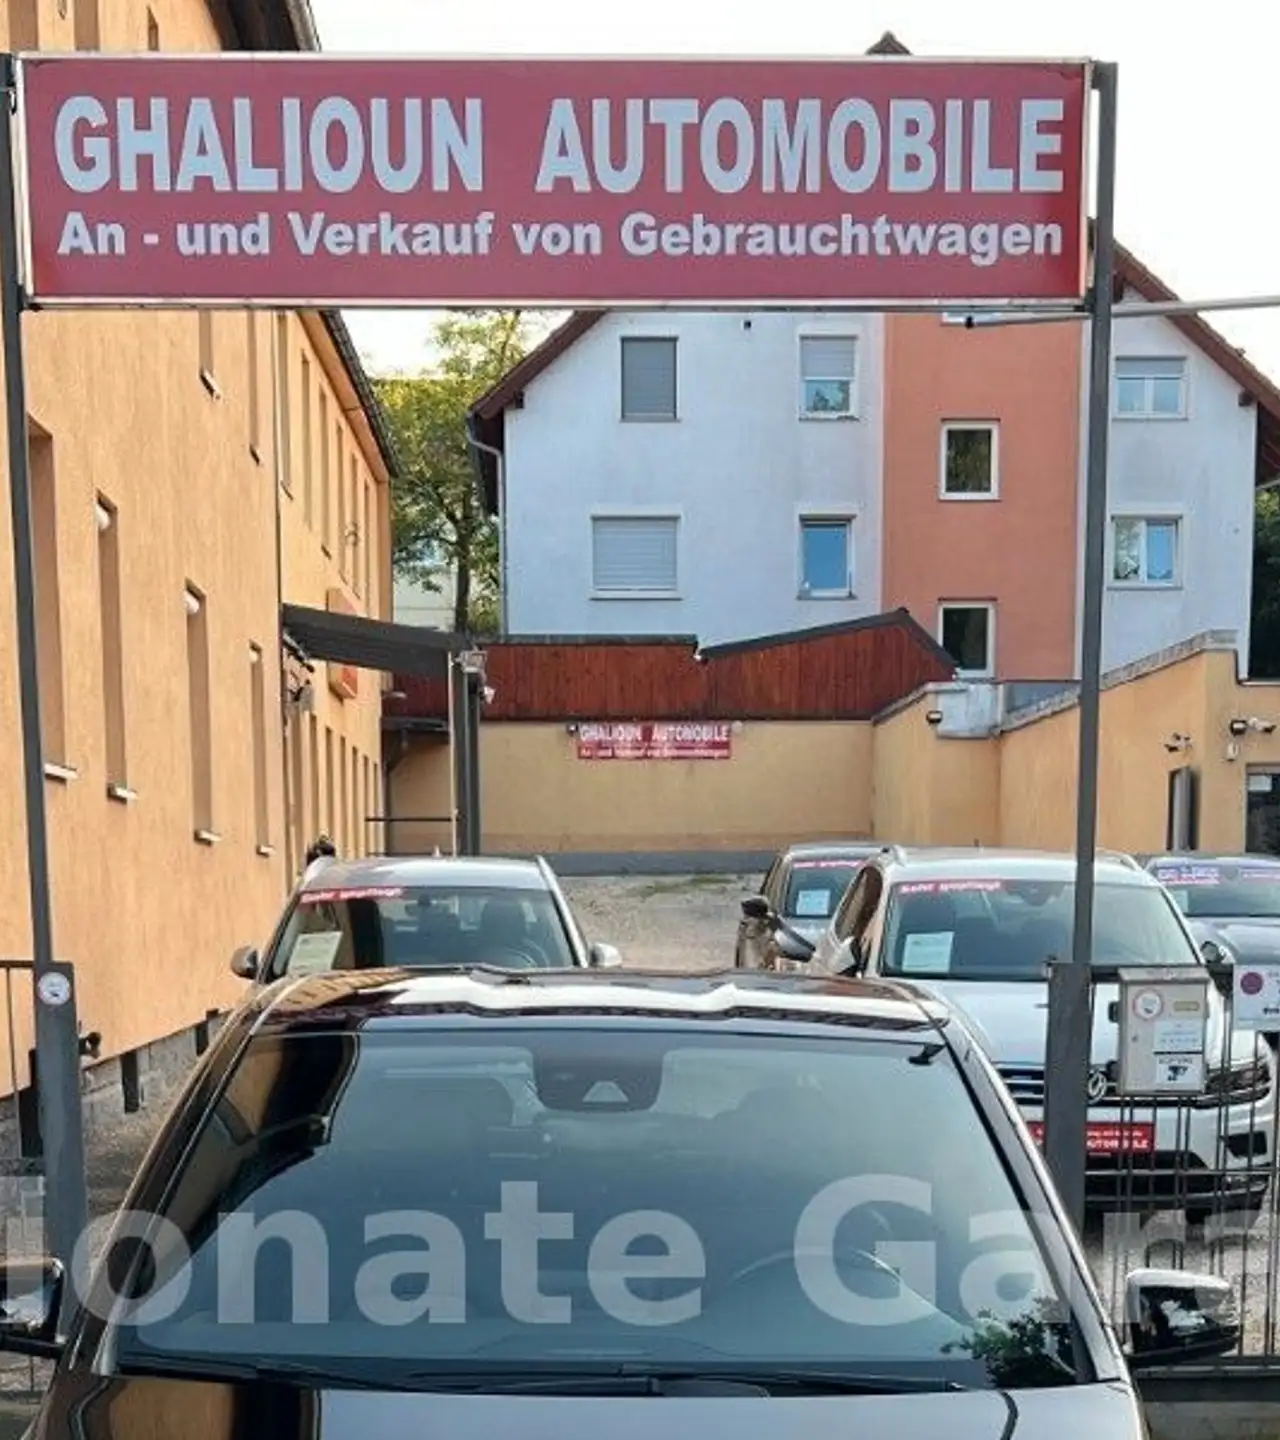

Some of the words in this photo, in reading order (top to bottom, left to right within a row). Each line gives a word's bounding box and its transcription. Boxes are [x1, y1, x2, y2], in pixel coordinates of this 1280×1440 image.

[54, 97, 483, 193] GHALIOUN
[535, 97, 1064, 193] AUTOMOBILE
[57, 212, 124, 255] An
[176, 212, 269, 255] und
[287, 211, 493, 256] Verkauf
[513, 223, 602, 256] von
[619, 210, 1064, 267] Gebrauchtwagen
